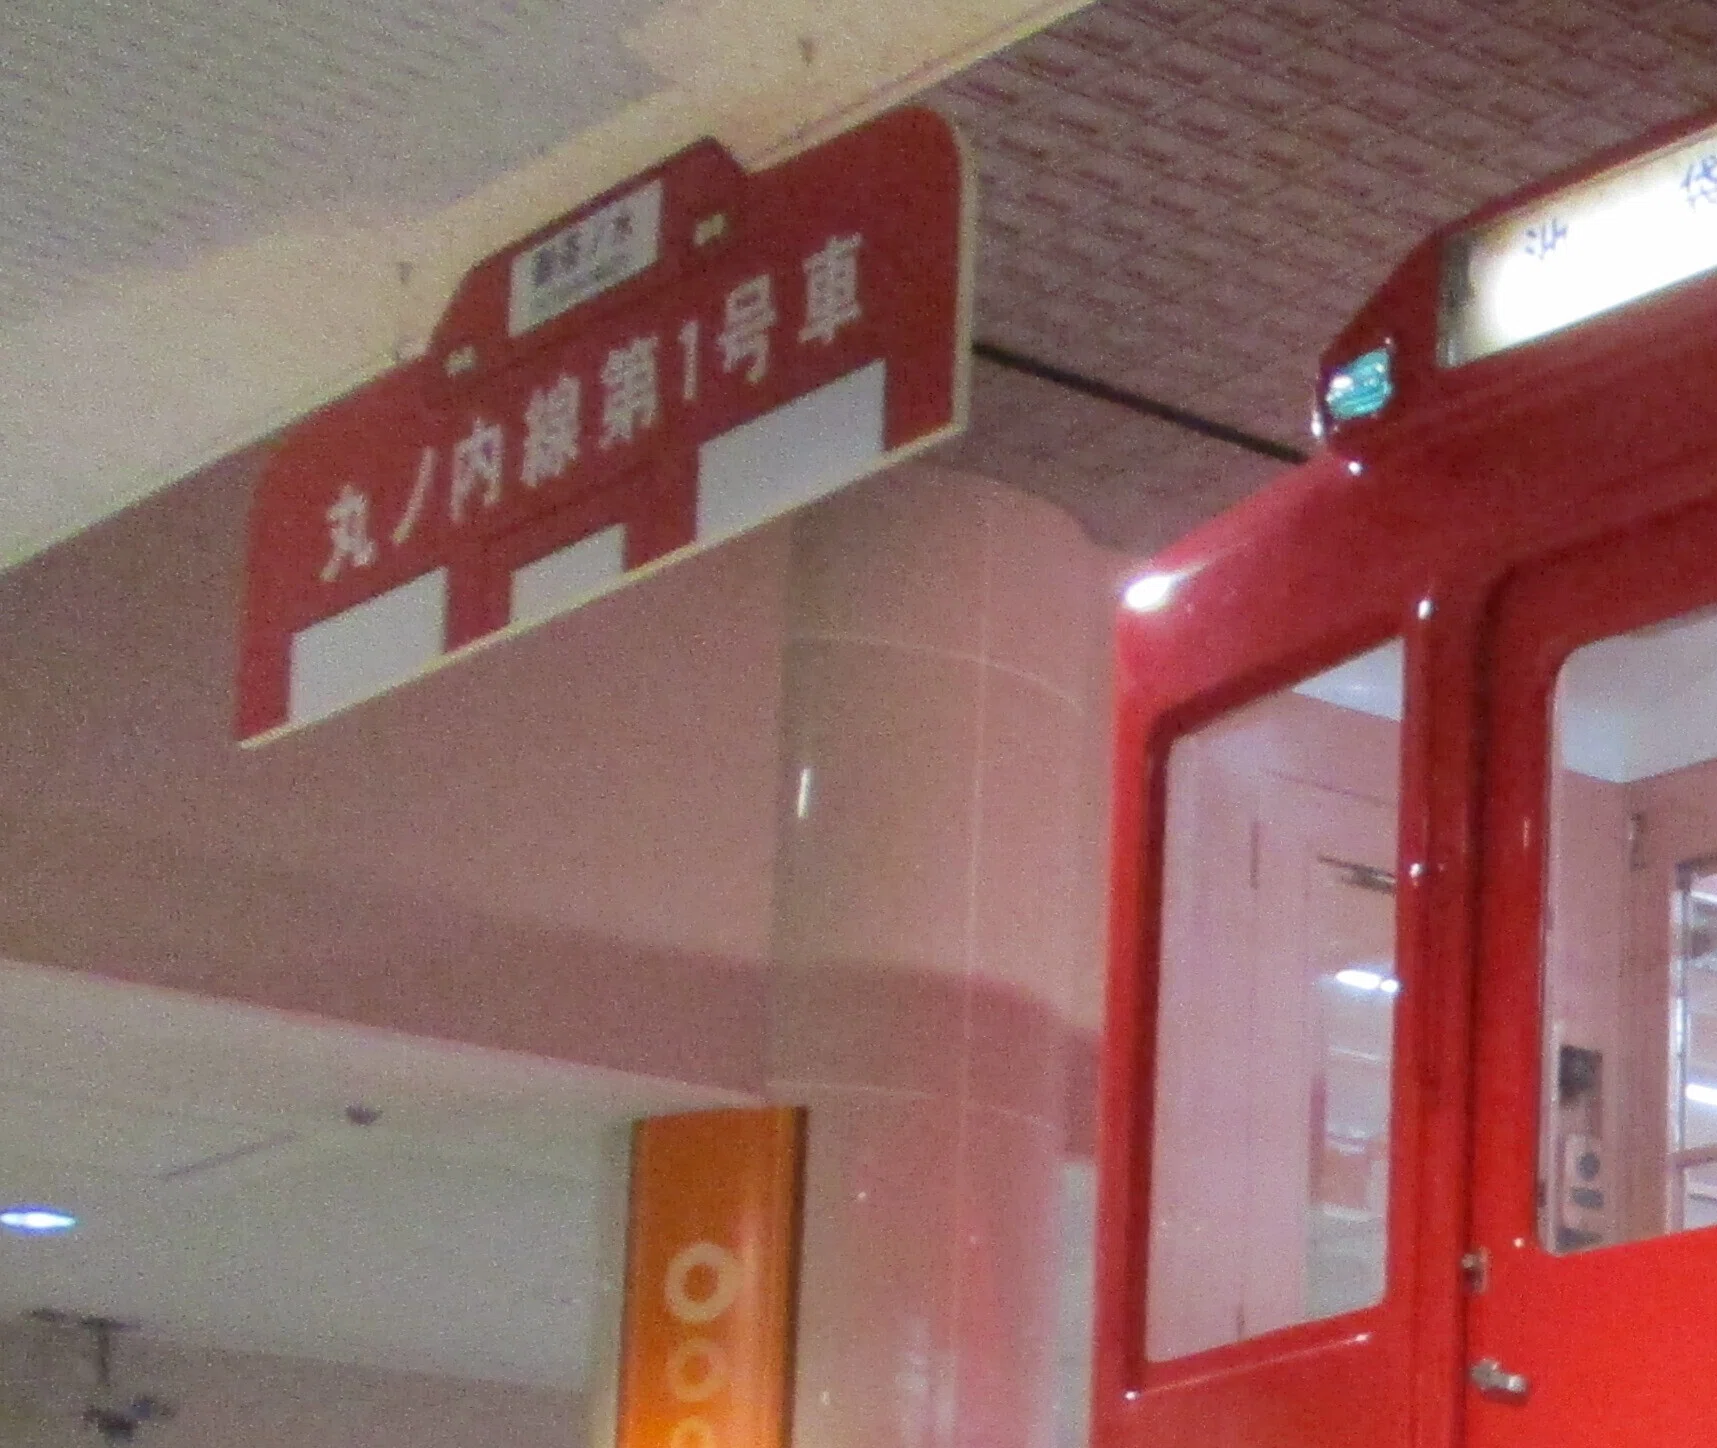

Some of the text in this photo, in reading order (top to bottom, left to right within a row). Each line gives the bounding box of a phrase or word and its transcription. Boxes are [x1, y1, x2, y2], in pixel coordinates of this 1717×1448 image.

[320, 232, 864, 582] 丸ノ内線第1号車
